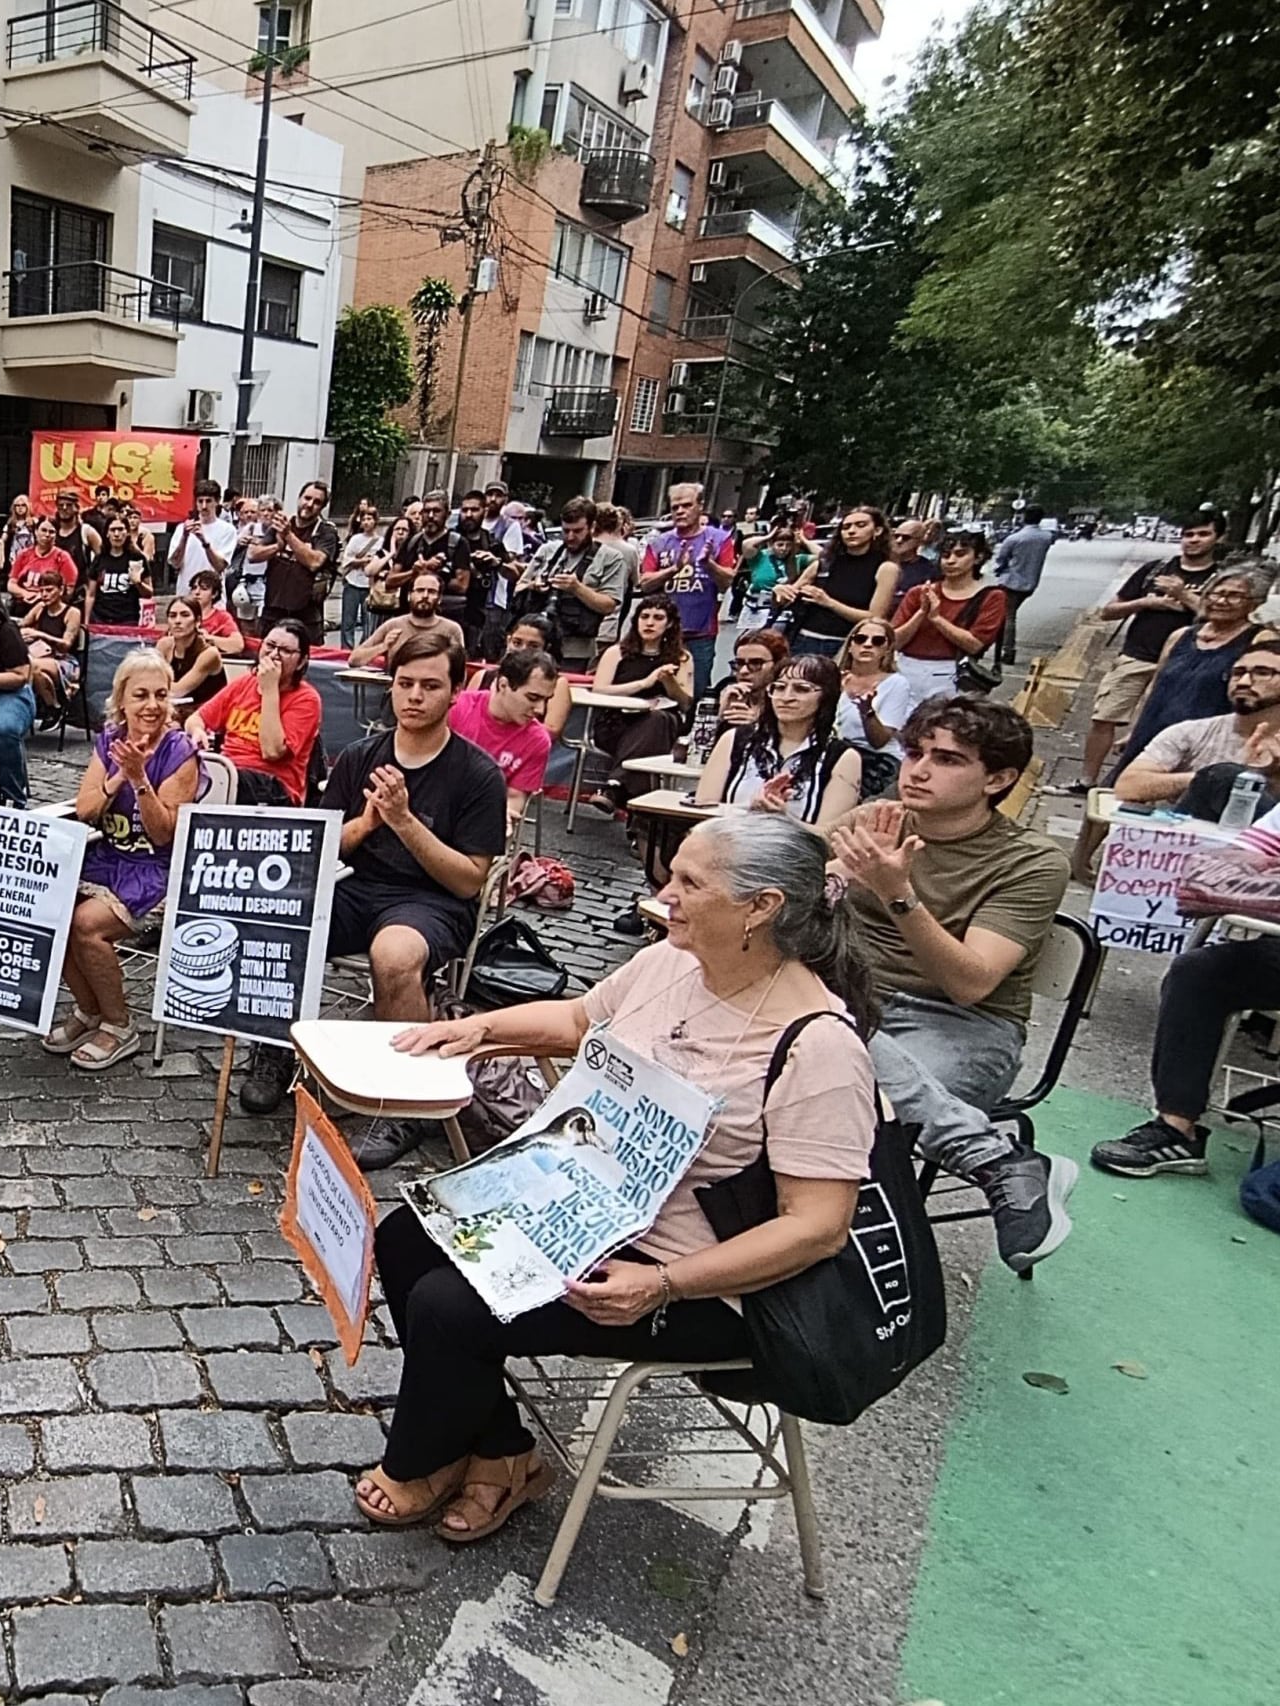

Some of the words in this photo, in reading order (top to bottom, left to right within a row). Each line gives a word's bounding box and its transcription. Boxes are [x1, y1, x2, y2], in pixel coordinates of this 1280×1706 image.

[40, 441, 150, 483] UJS
[664, 579, 704, 593] UBA
[24, 821, 50, 839] DE
[194, 828, 214, 849] NO
[216, 828, 234, 850] AL
[237, 829, 289, 851] CIERRE
[291, 829, 313, 852] DE
[5, 875, 13, 885] Y
[14, 876, 49, 893] TRUMP
[189, 852, 254, 895] fate
[1099, 871, 1183, 899] Docent
[0, 901, 32, 918] LUCHA
[199, 893, 243, 911] NINGÚN
[245, 897, 302, 916] DESPIDO!
[12, 940, 34, 956] DE
[266, 942, 282, 959] CON
[282, 943, 291, 960] EL
[266, 961, 272, 977] Y
[272, 962, 286, 979] LOS
[237, 996, 250, 1014] DEL
[584, 1089, 630, 1133] AGUA
[629, 1121, 657, 1151] DE
[655, 1141, 685, 1174] UN
[634, 1094, 700, 1152] SOMOS
[613, 1136, 668, 1193] MISMO
[561, 1189, 594, 1215] DE
[585, 1211, 620, 1240] UN
[538, 1200, 597, 1256] MISMO
